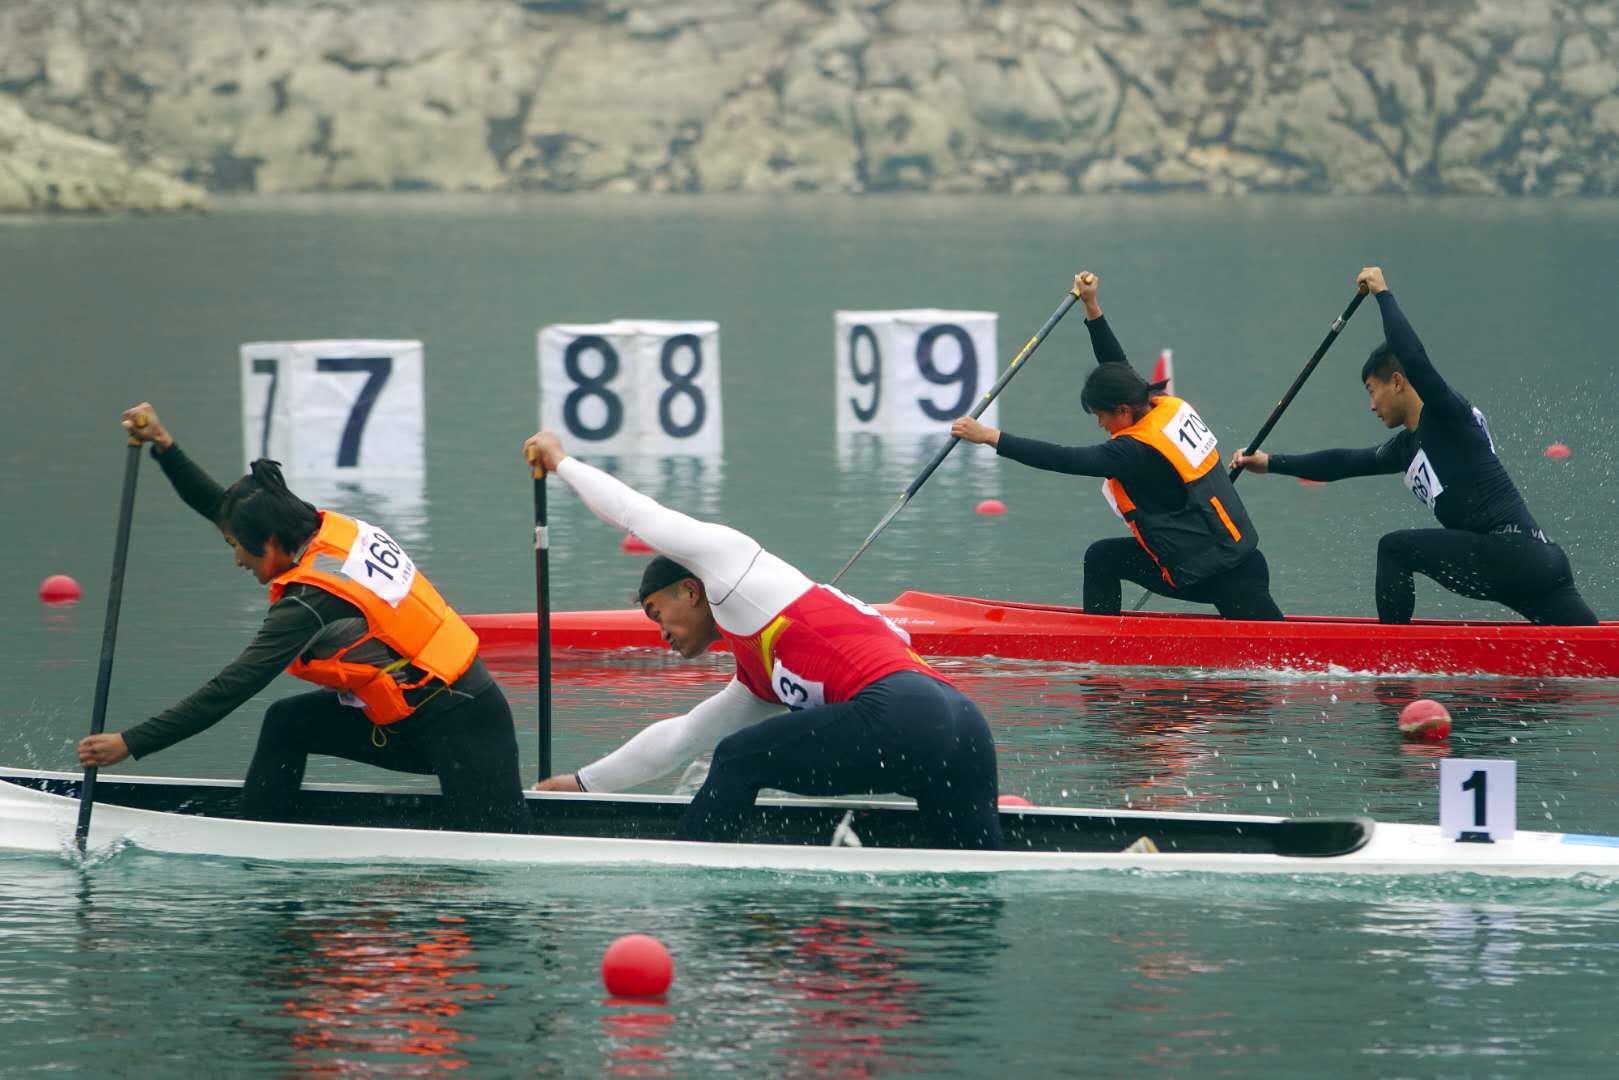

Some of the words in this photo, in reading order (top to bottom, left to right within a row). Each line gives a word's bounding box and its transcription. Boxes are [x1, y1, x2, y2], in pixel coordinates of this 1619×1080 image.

[252, 358, 278, 457] 7
[316, 357, 393, 468] 7
[563, 334, 624, 441] 8
[658, 333, 706, 439] 8
[850, 324, 881, 422] 9
[916, 323, 978, 421] 9
[1178, 414, 1208, 448] 170
[364, 533, 400, 580] 168
[1462, 770, 1487, 827] 1
